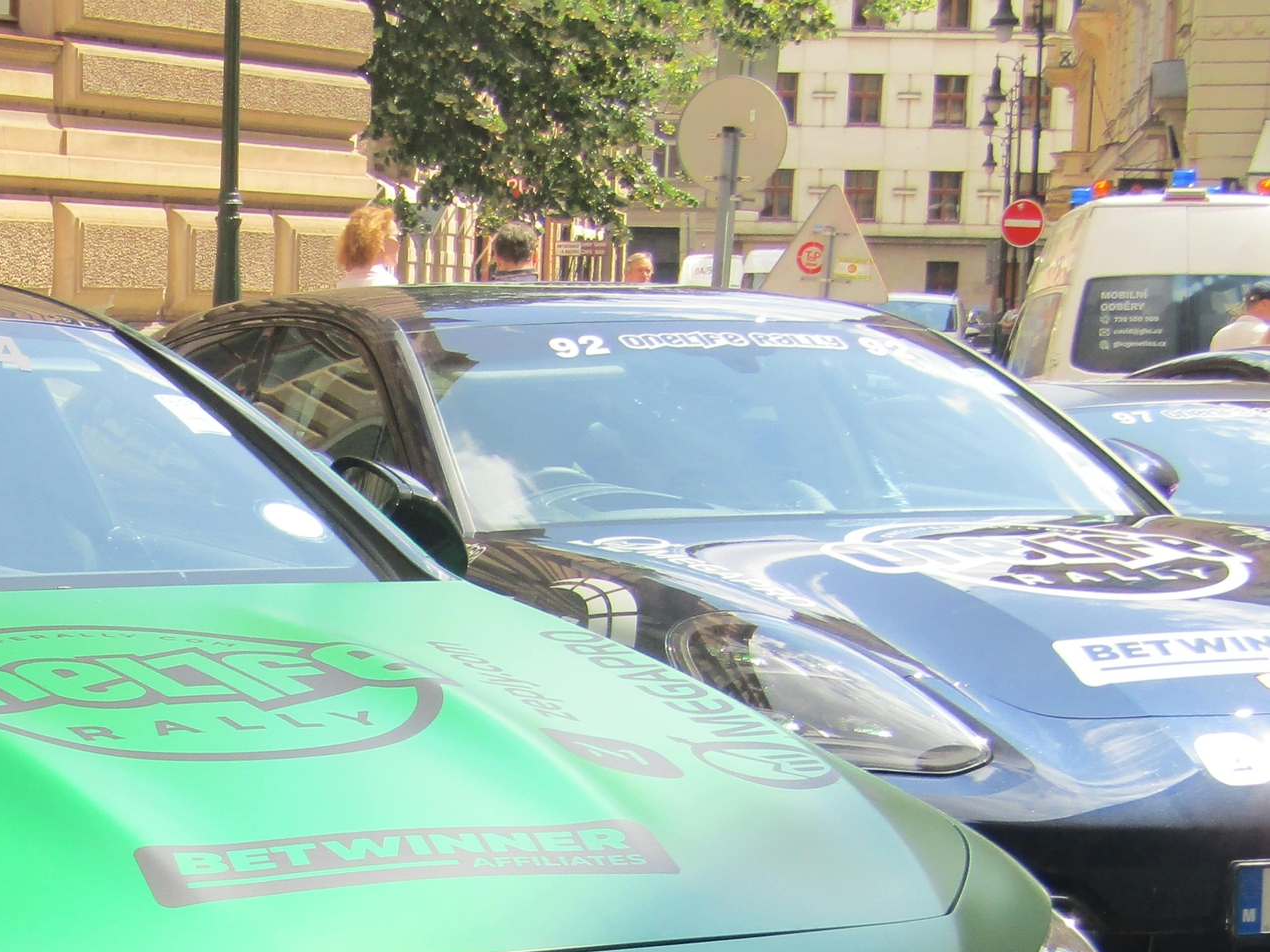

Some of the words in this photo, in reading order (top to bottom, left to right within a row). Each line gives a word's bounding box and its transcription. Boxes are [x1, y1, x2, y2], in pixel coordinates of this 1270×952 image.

[548, 335, 611, 359] 92
[857, 336, 916, 359] 92
[1111, 410, 1153, 425] 97
[1012, 567, 1211, 586] RALLY
[67, 710, 388, 742] RALLY
[173, 828, 633, 876] BETWINNER
[473, 853, 648, 869] AFFILIATES
[1242, 908, 1256, 923] M
